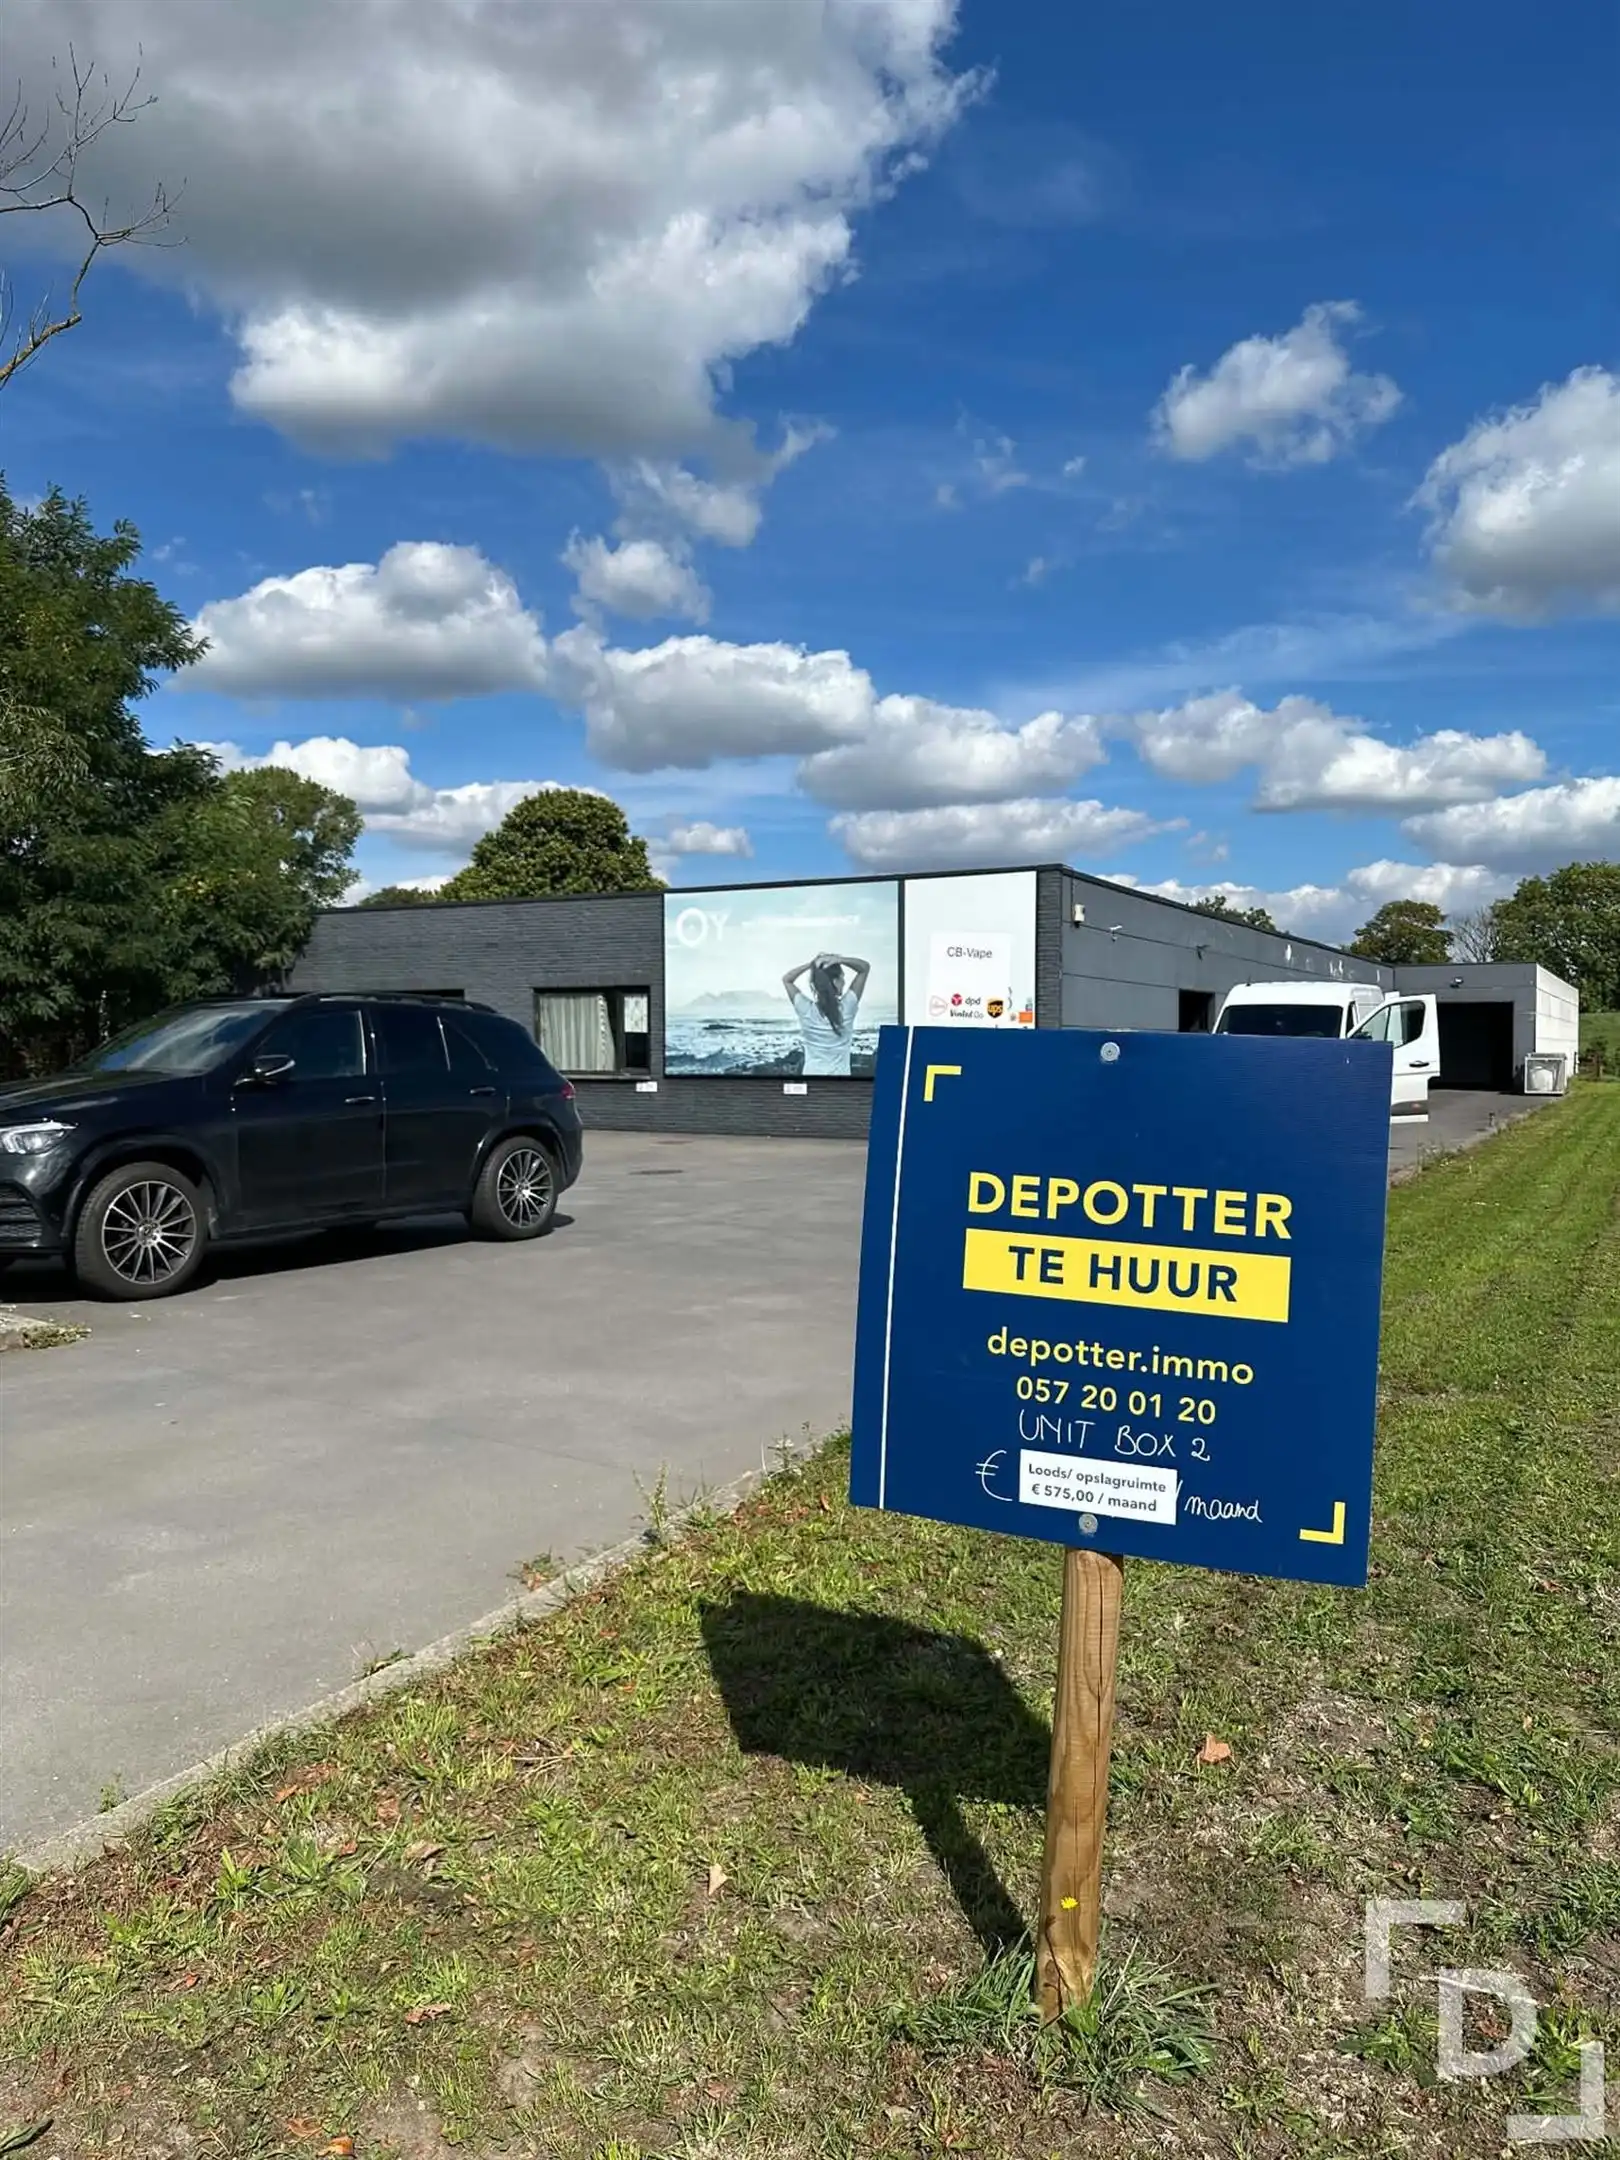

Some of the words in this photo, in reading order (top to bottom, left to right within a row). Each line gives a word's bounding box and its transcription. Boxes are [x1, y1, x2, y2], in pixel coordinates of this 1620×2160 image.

[946, 946, 993, 959] CB-Vape
[965, 996, 981, 1006] dpd
[967, 1171, 1293, 1239] DEPOTTER
[1008, 1245, 1064, 1285] TE
[1088, 1253, 1238, 1302] HUUR
[987, 1326, 1254, 1385] depotter.immo
[1016, 1376, 1069, 1404] 057
[1081, 1385, 1117, 1411] 20
[1128, 1391, 1162, 1418] 01
[1178, 1397, 1216, 1424] 20
[1019, 1409, 1096, 1449] UNIT
[1114, 1425, 1176, 1457] BOX
[1191, 1438, 1211, 1462] 2
[975, 1450, 1013, 1502] €
[1028, 1463, 1073, 1480] Loods/
[1076, 1472, 1167, 1493] opslagruimte
[1031, 1484, 1040, 1495] €
[1044, 1484, 1095, 1503] 575,00
[1097, 1493, 1105, 1505] /
[1108, 1496, 1157, 1512] maand
